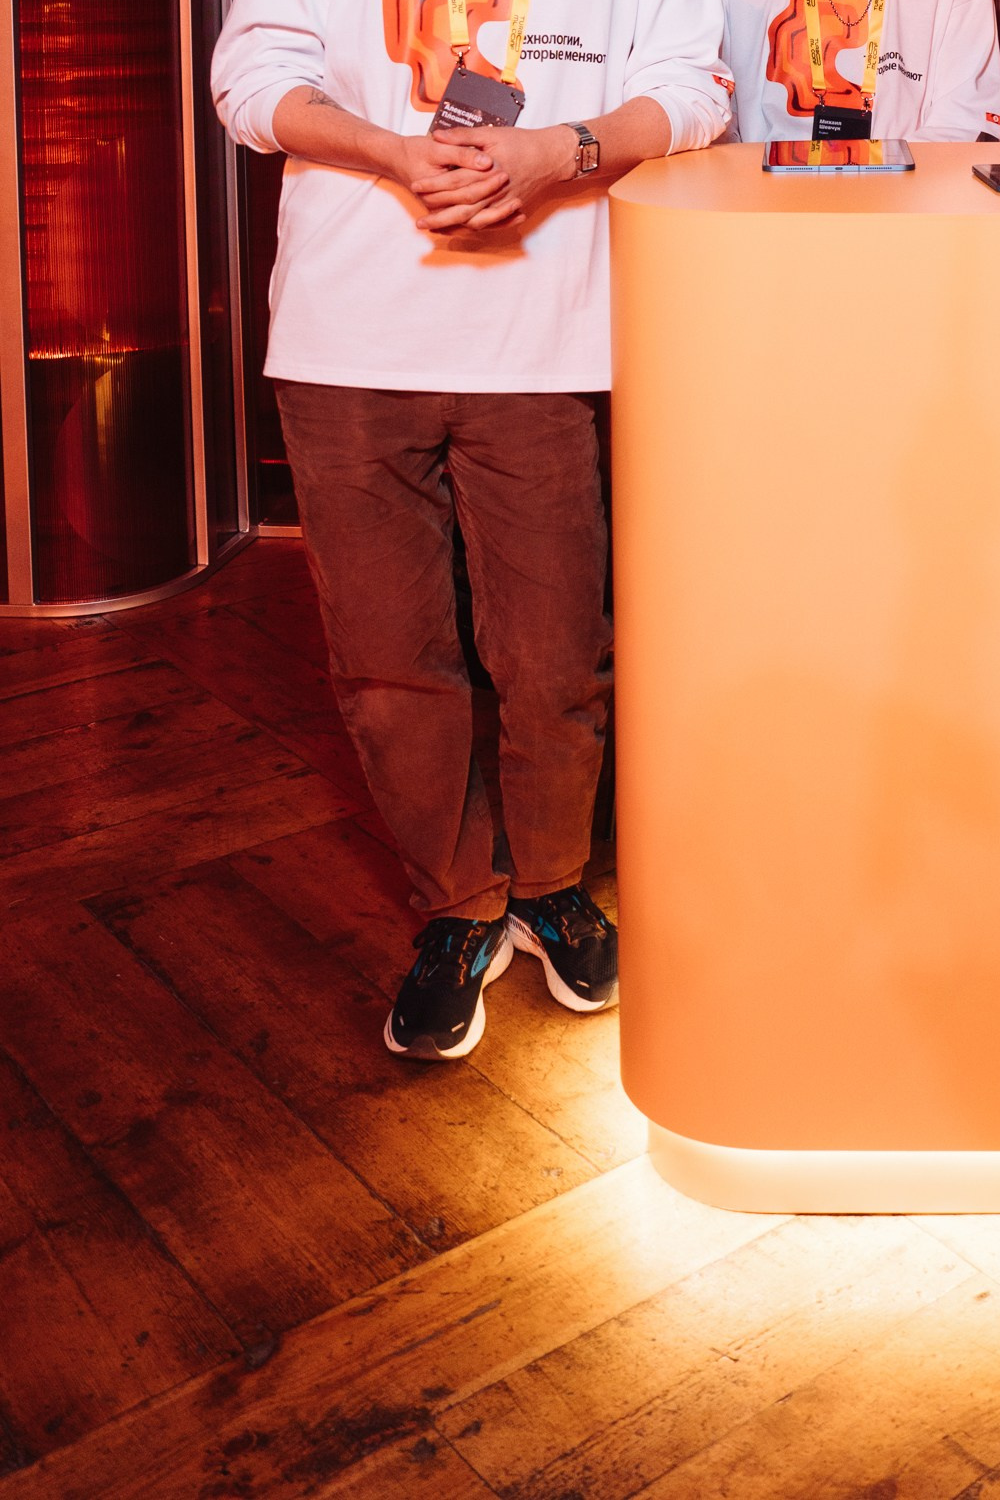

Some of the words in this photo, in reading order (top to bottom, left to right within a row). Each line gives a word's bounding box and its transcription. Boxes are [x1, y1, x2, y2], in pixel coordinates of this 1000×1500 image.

[523, 34, 583, 48] ехнологии,
[520, 49, 563, 62] оторые
[444, 104, 483, 122] Александр
